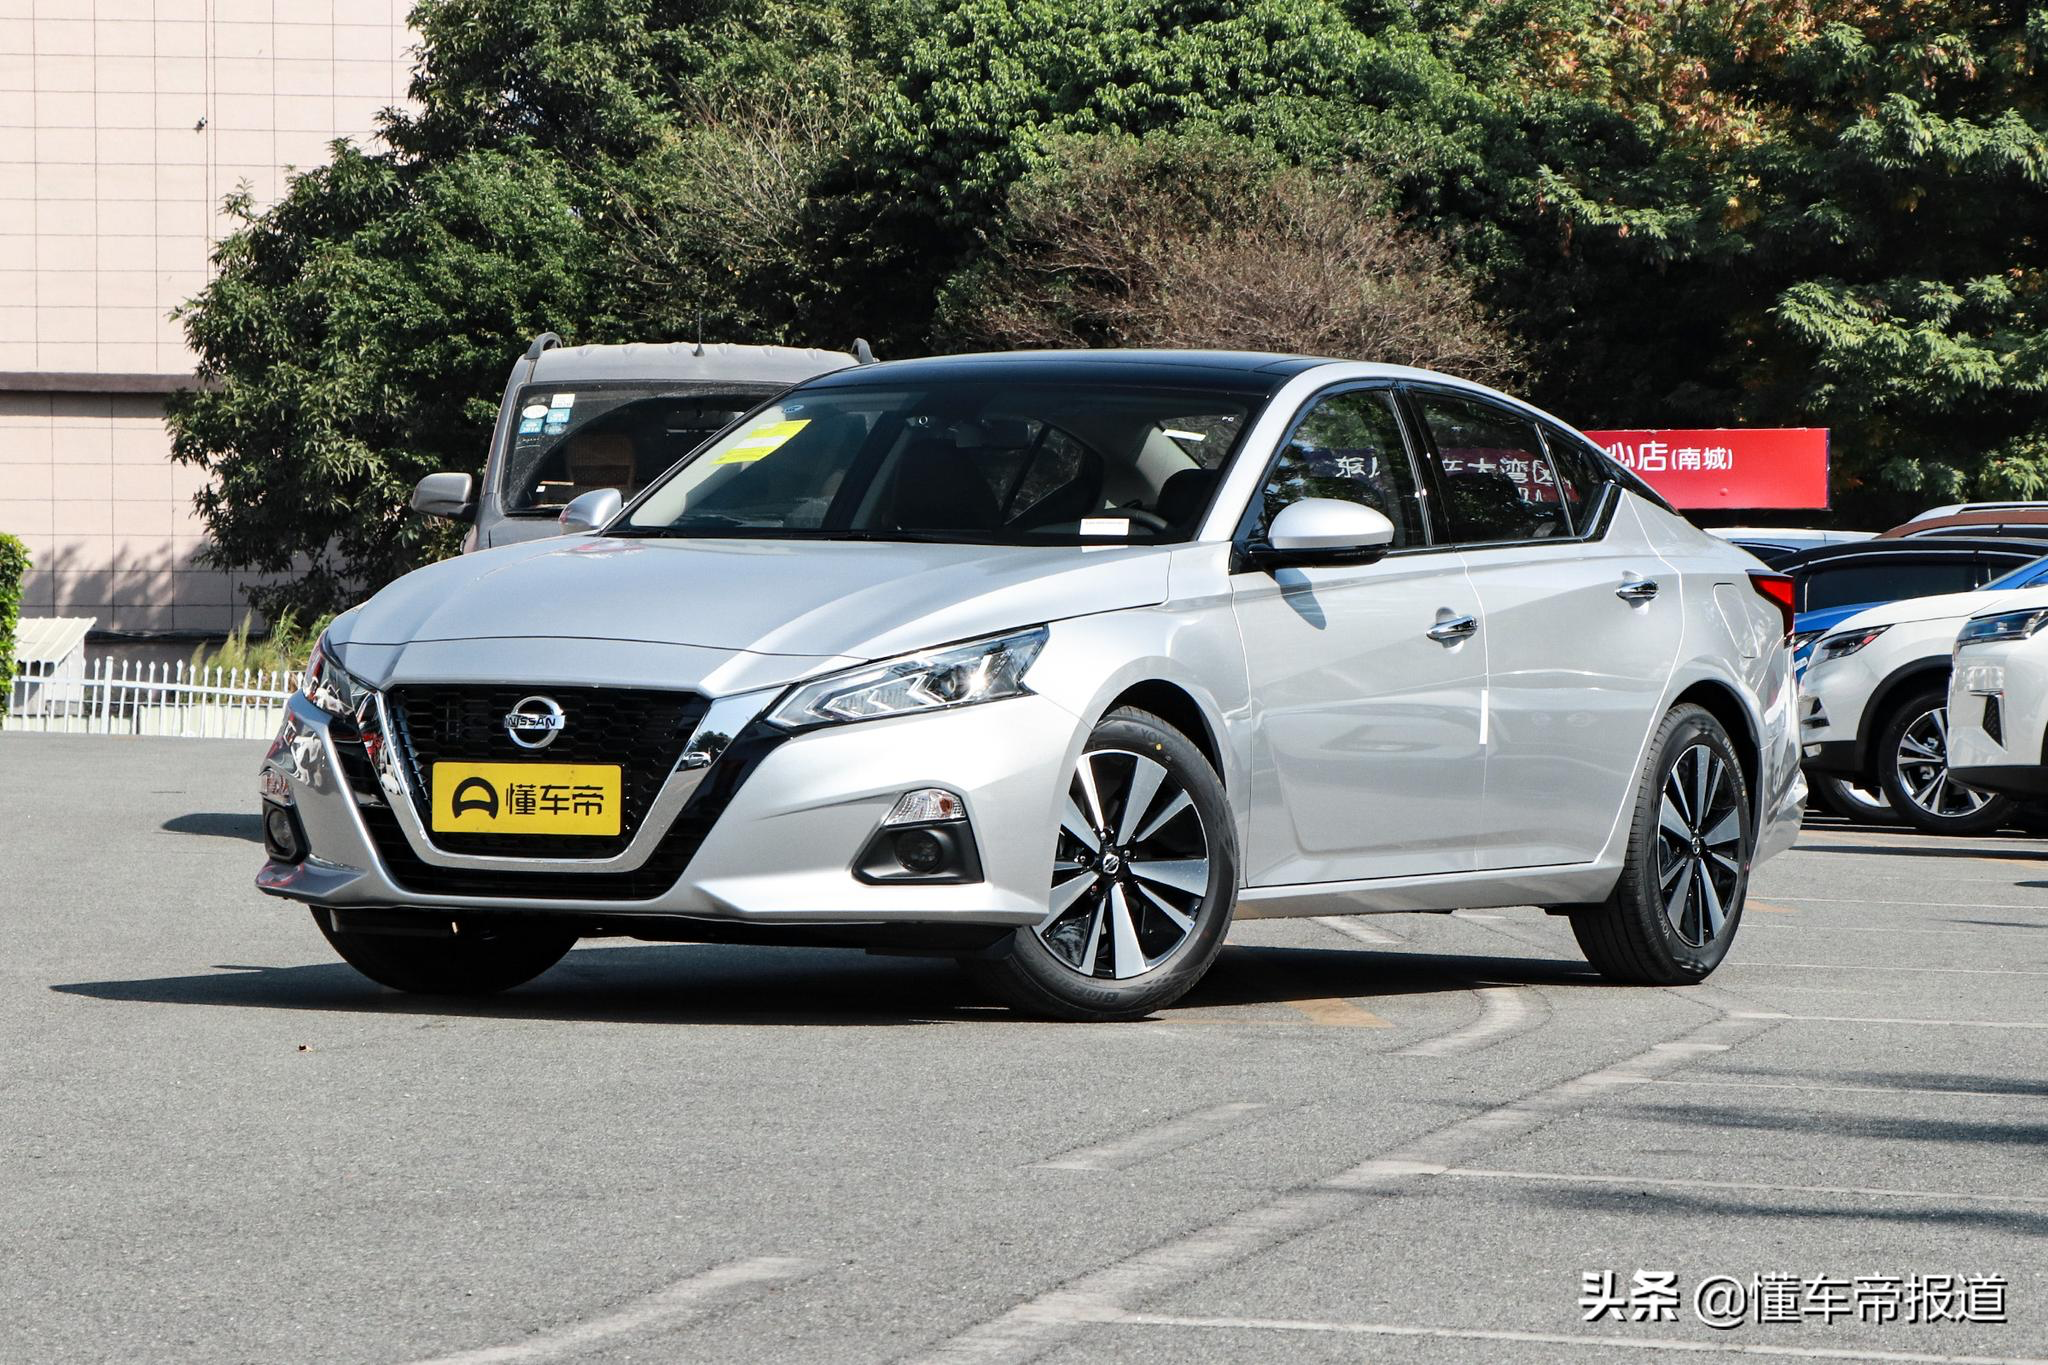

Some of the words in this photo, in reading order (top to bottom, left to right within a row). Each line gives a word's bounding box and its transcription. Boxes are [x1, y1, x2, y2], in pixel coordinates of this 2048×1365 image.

[506, 715, 558, 729] NISSAN
[505, 782, 604, 816] 懂车帝
